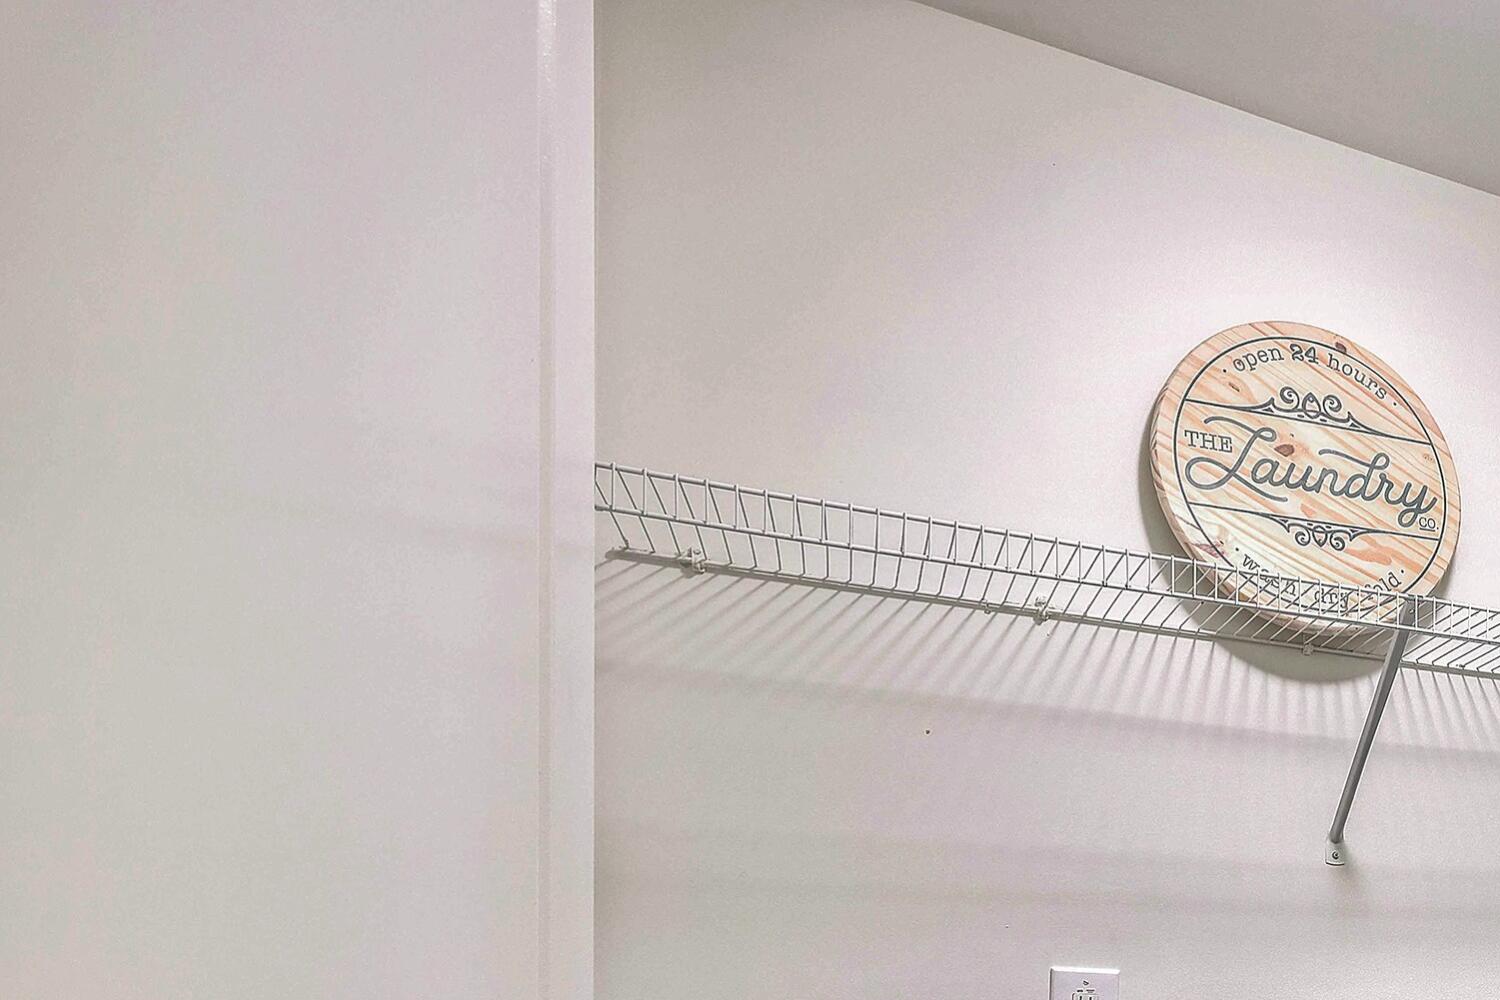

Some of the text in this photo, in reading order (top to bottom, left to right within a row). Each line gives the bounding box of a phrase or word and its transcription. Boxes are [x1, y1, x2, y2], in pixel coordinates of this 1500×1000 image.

[1232, 343, 1387, 400] open 24 hours
[1184, 429, 1233, 453] THE
[1184, 416, 1437, 528] Laundry
